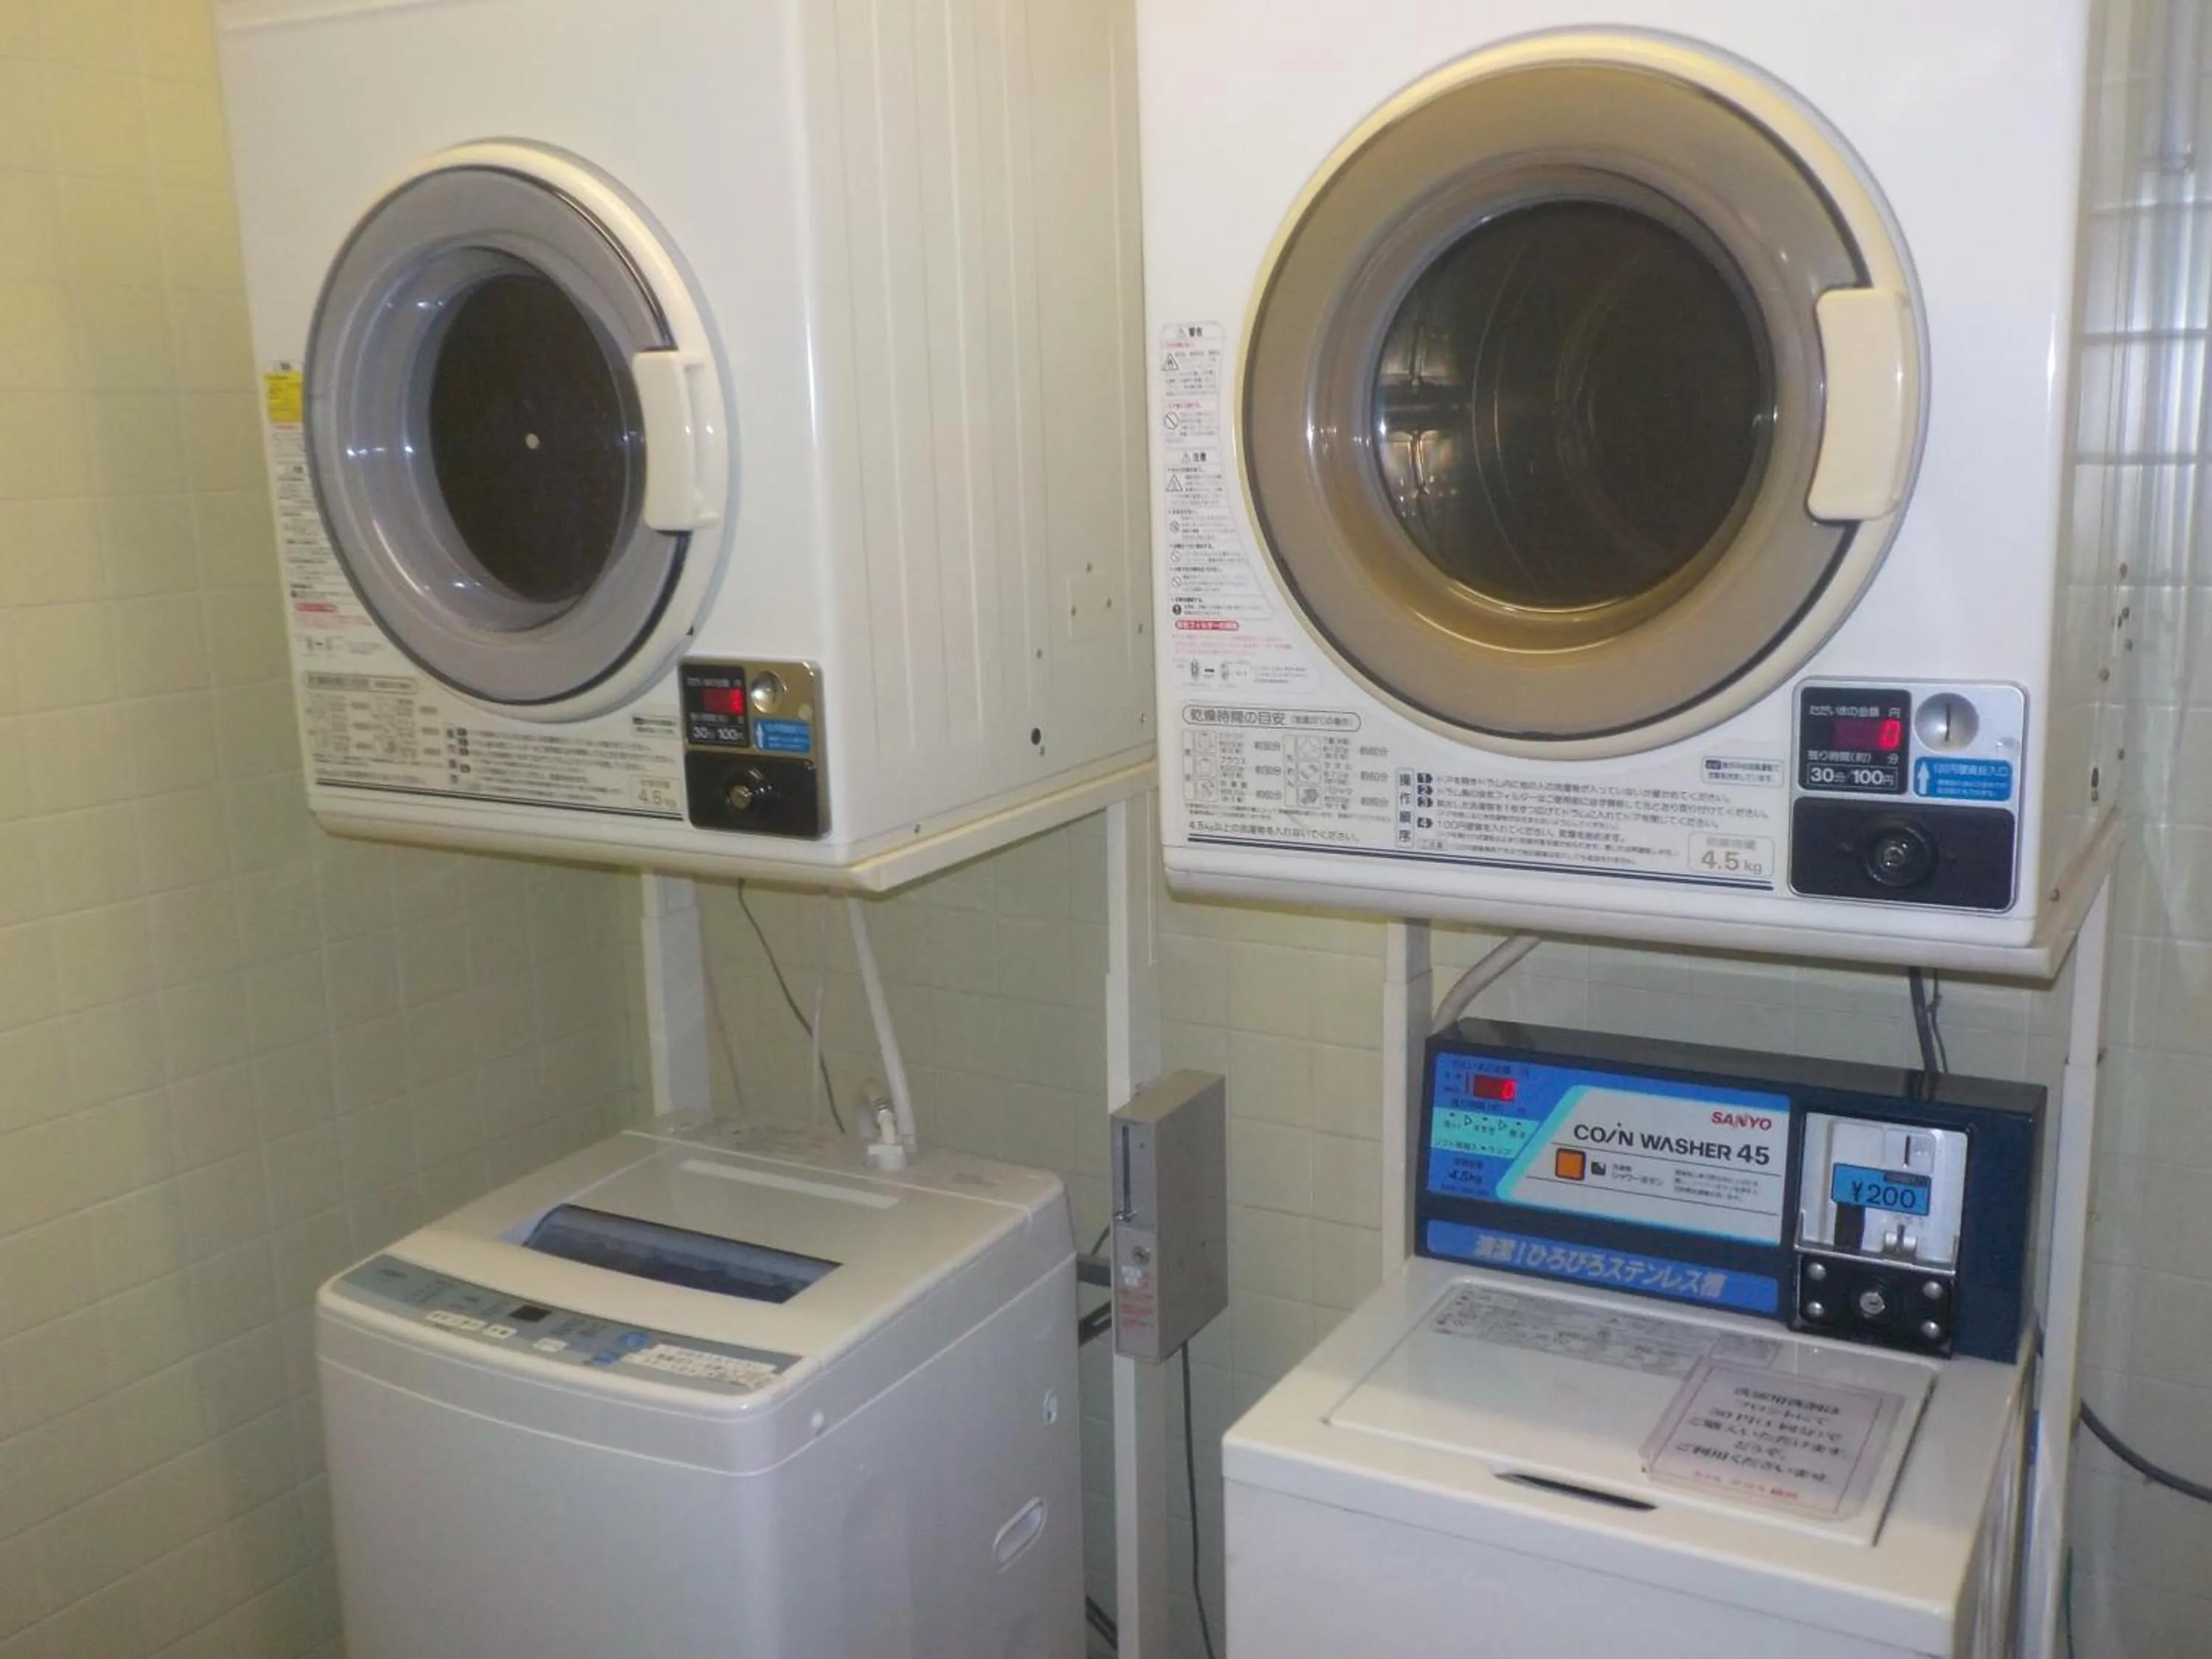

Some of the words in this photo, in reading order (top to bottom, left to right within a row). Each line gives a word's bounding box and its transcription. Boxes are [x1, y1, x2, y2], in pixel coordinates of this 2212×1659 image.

[1190, 709, 1285, 726] 乾燥時間の目安
[1701, 849, 1739, 872] 4.5
[1744, 859, 1763, 874] kg
[1711, 1111, 1773, 1131] SANYO
[1640, 1133, 1732, 1161] WASHER
[1736, 1144, 1770, 1166] 45
[1851, 1181, 1916, 1209] ¥200
